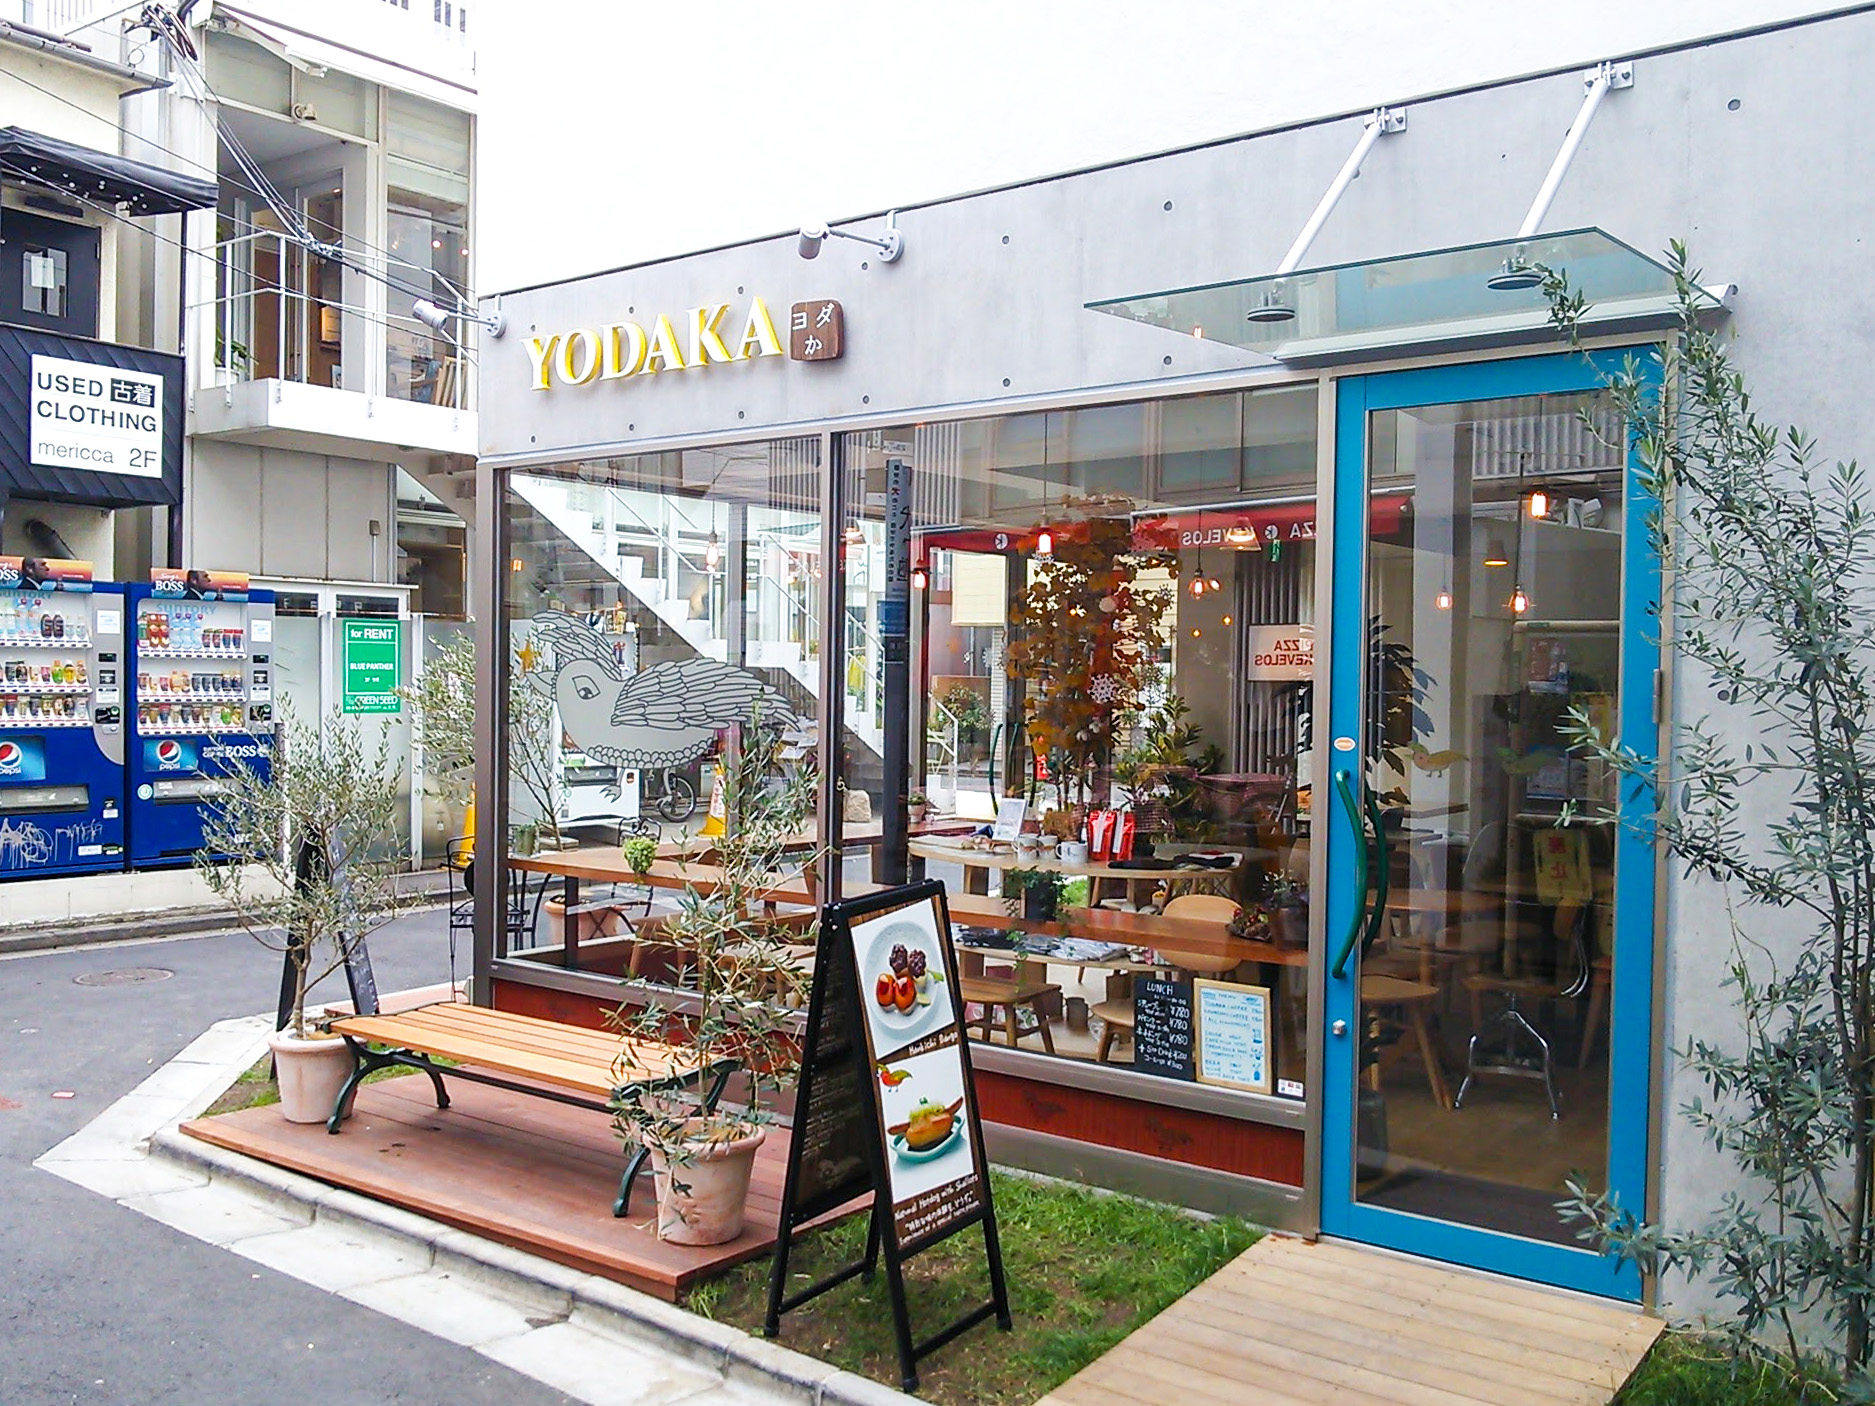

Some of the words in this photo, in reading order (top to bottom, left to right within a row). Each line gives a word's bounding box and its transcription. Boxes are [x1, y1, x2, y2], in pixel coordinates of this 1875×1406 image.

[520, 296, 784, 391] YODAKA
[37, 372, 104, 398] USED
[111, 379, 154, 407] 古着
[36, 400, 157, 433] CLOTHING
[38, 442, 114, 464] mericca
[129, 448, 158, 468] 2F
[155, 580, 184, 591] BOSS
[350, 628, 363, 638] for
[363, 628, 394, 640] RENT
[349, 662, 366, 671] BLUE
[366, 662, 395, 671] PANTHER
[1146, 981, 1174, 996] LUNCH
